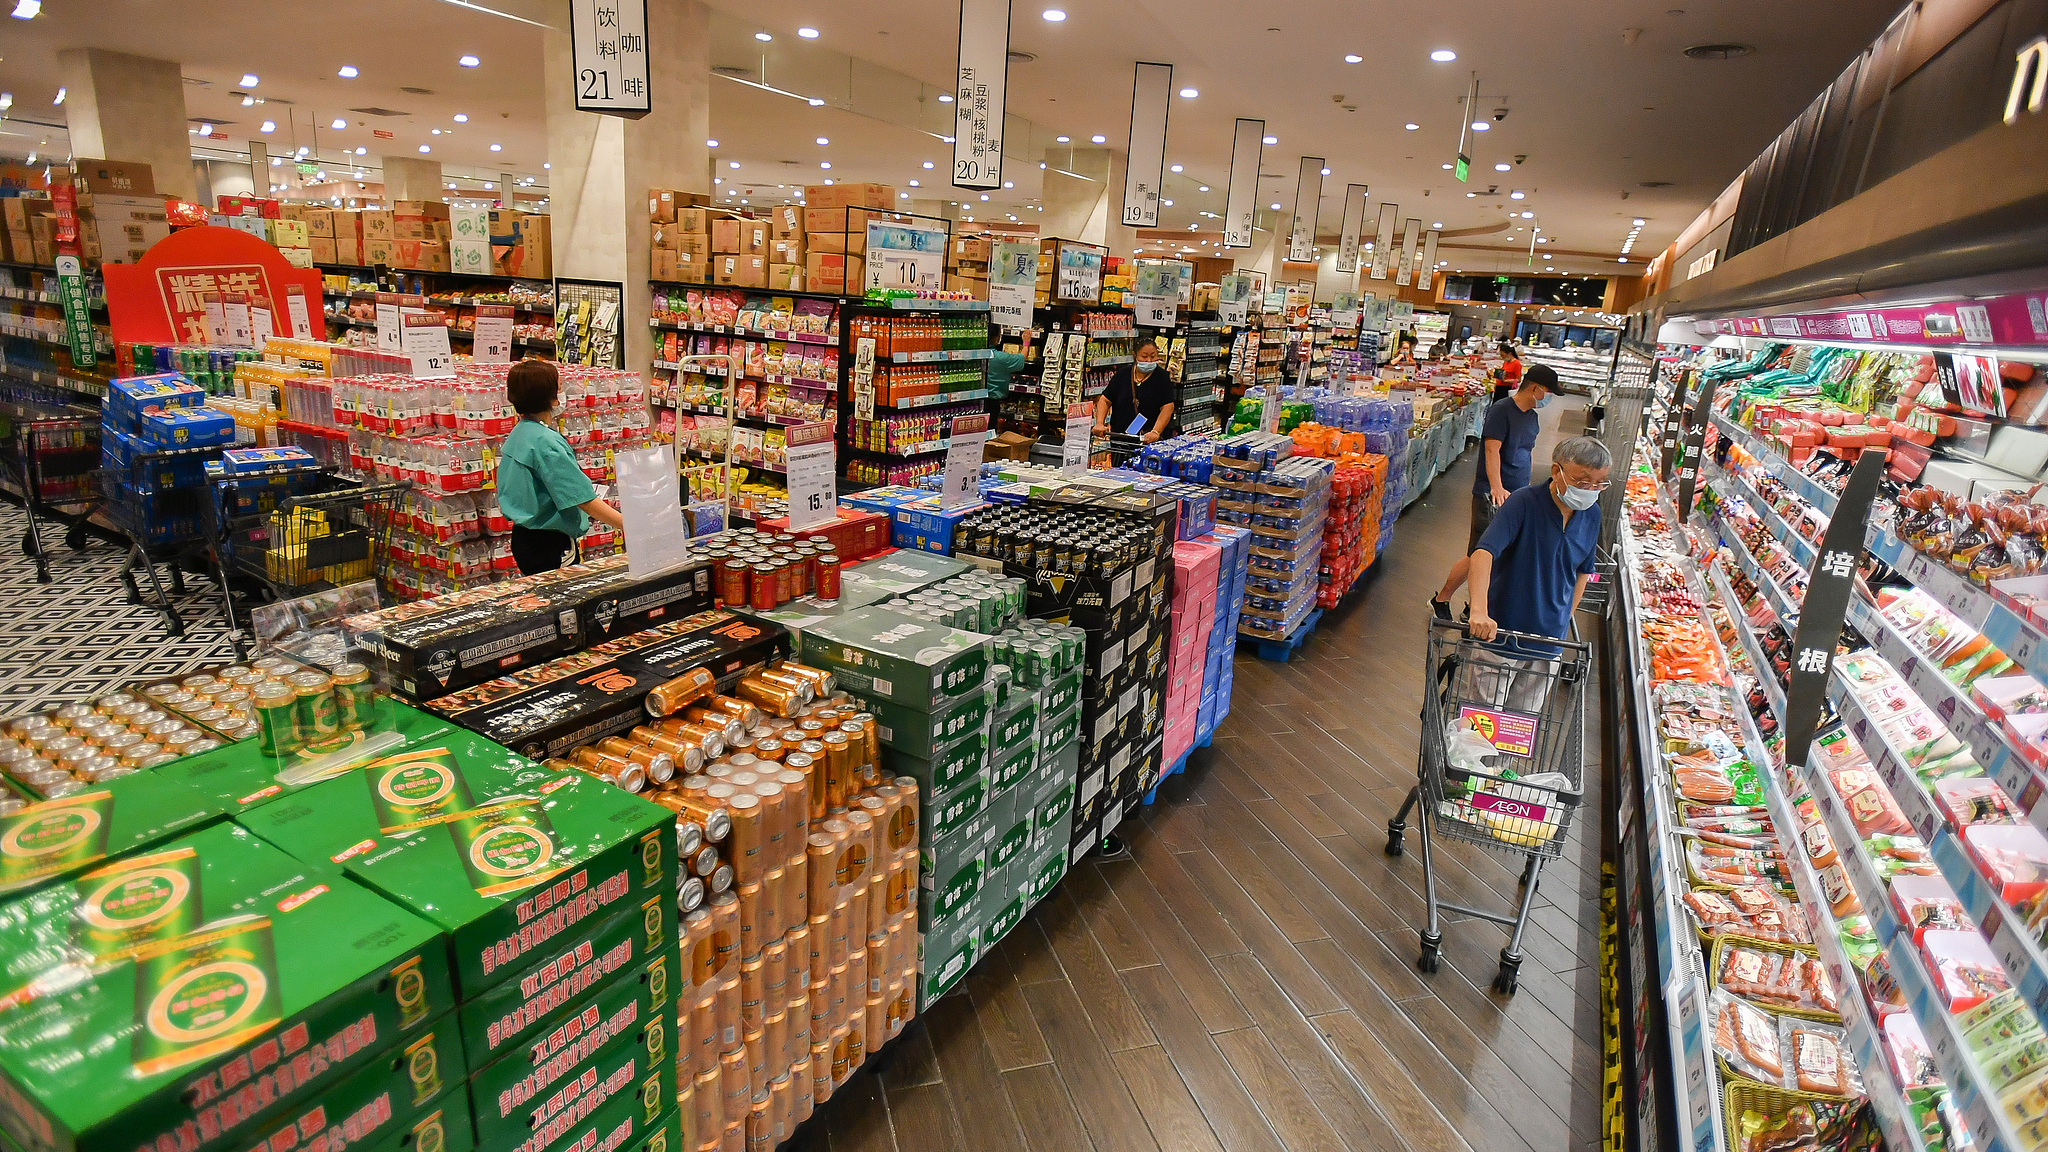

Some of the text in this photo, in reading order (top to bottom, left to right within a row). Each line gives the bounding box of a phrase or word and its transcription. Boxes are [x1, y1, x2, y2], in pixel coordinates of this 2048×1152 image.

[596, 7, 618, 60] 饮料
[621, 33, 644, 97] 咖啡
[580, 69, 614, 100] 21
[959, 67, 973, 121] 芝麻糊
[956, 160, 979, 180] 20
[986, 139, 999, 180] 麦片
[1137, 183, 1147, 193] 茶
[1145, 191, 1157, 220] 咖啡
[1126, 206, 1141, 221] 19
[1226, 231, 1239, 243] 18
[1292, 249, 1302, 260] 17
[1339, 261, 1347, 269] 16
[1680, 423, 1704, 480] 火腿肠
[1798, 550, 1855, 675] 培根
[516, 869, 588, 925] 优质啤酒
[520, 940, 593, 1000] 优质啤酒
